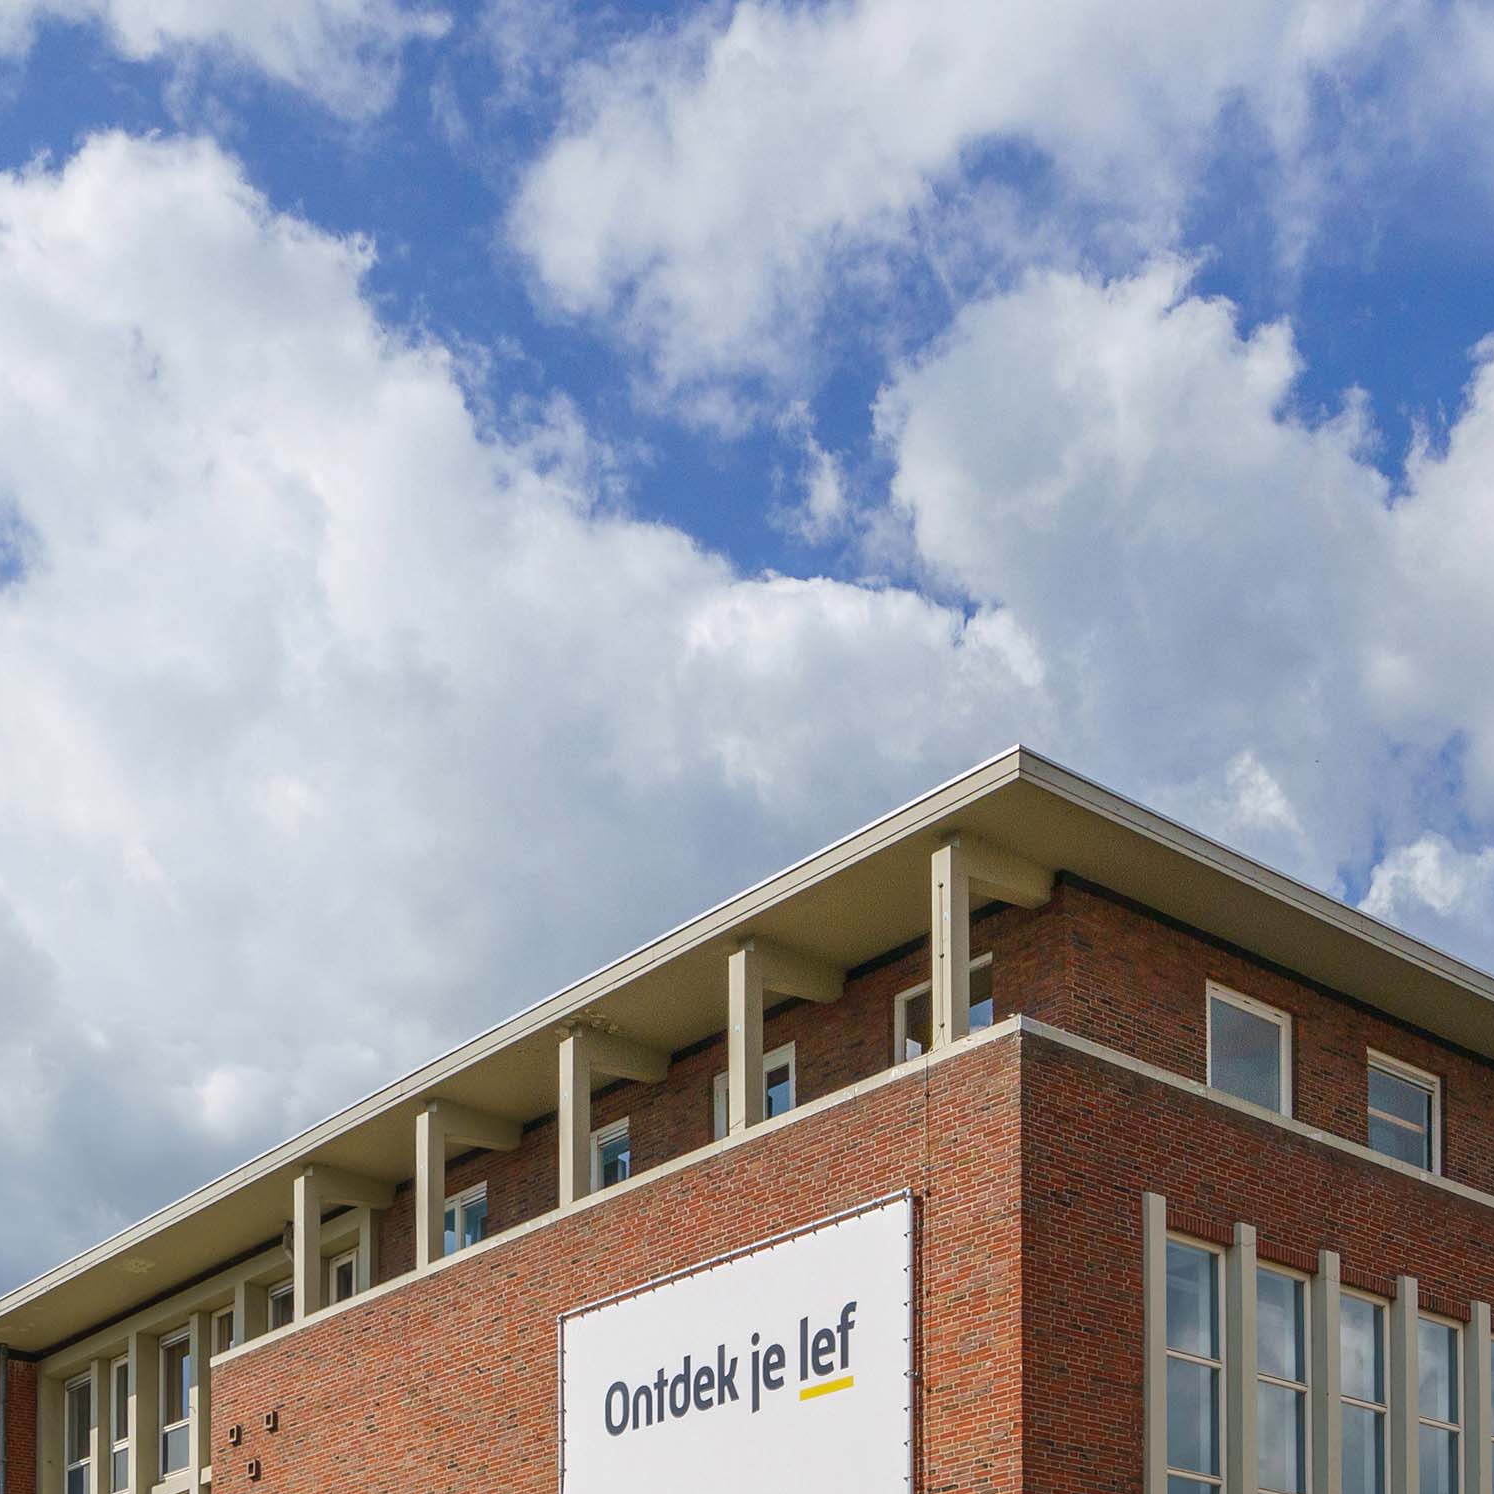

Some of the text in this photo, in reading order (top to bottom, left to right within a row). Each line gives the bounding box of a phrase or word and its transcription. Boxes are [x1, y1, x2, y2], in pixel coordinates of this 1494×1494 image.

[604, 1301, 857, 1437] Ontdek je lef
